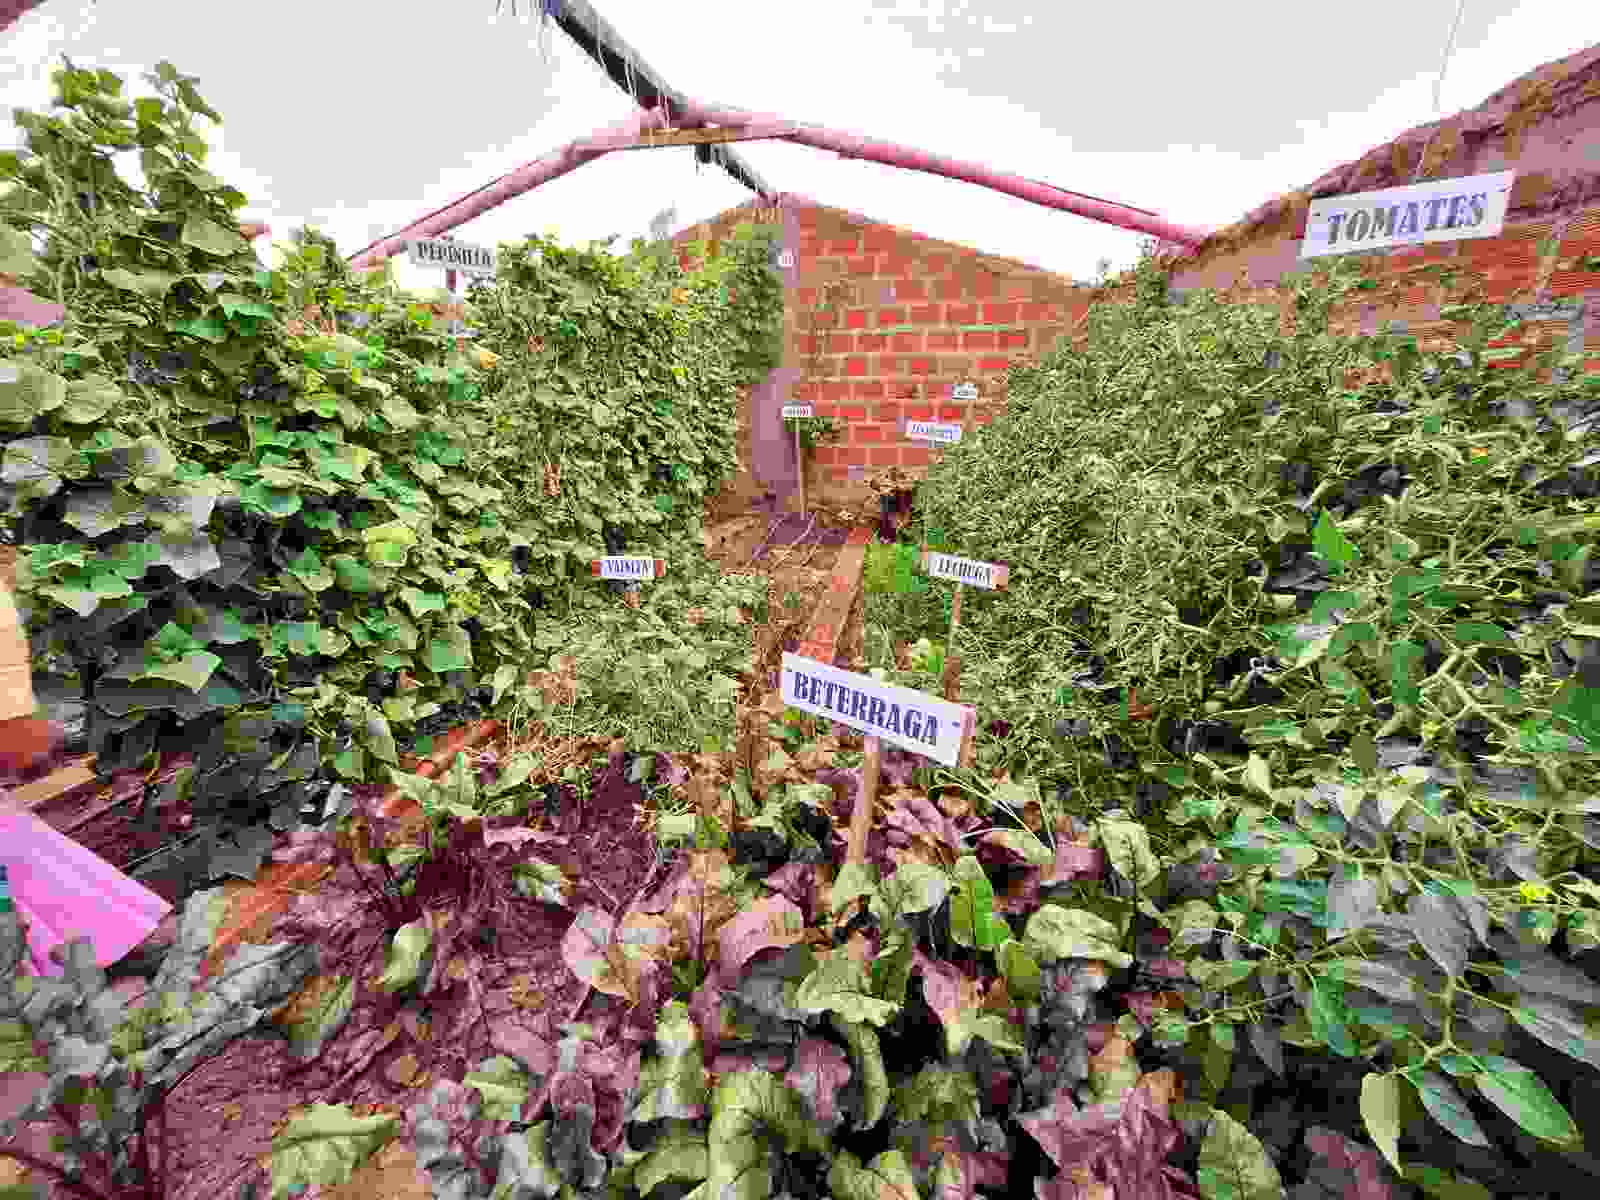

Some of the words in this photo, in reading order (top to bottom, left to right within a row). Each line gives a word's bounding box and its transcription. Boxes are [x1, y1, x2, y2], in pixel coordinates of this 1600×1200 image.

[1328, 192, 1487, 244] TOMATES
[937, 557, 990, 585] LECHUGA
[793, 671, 938, 746] BETERRAGA
